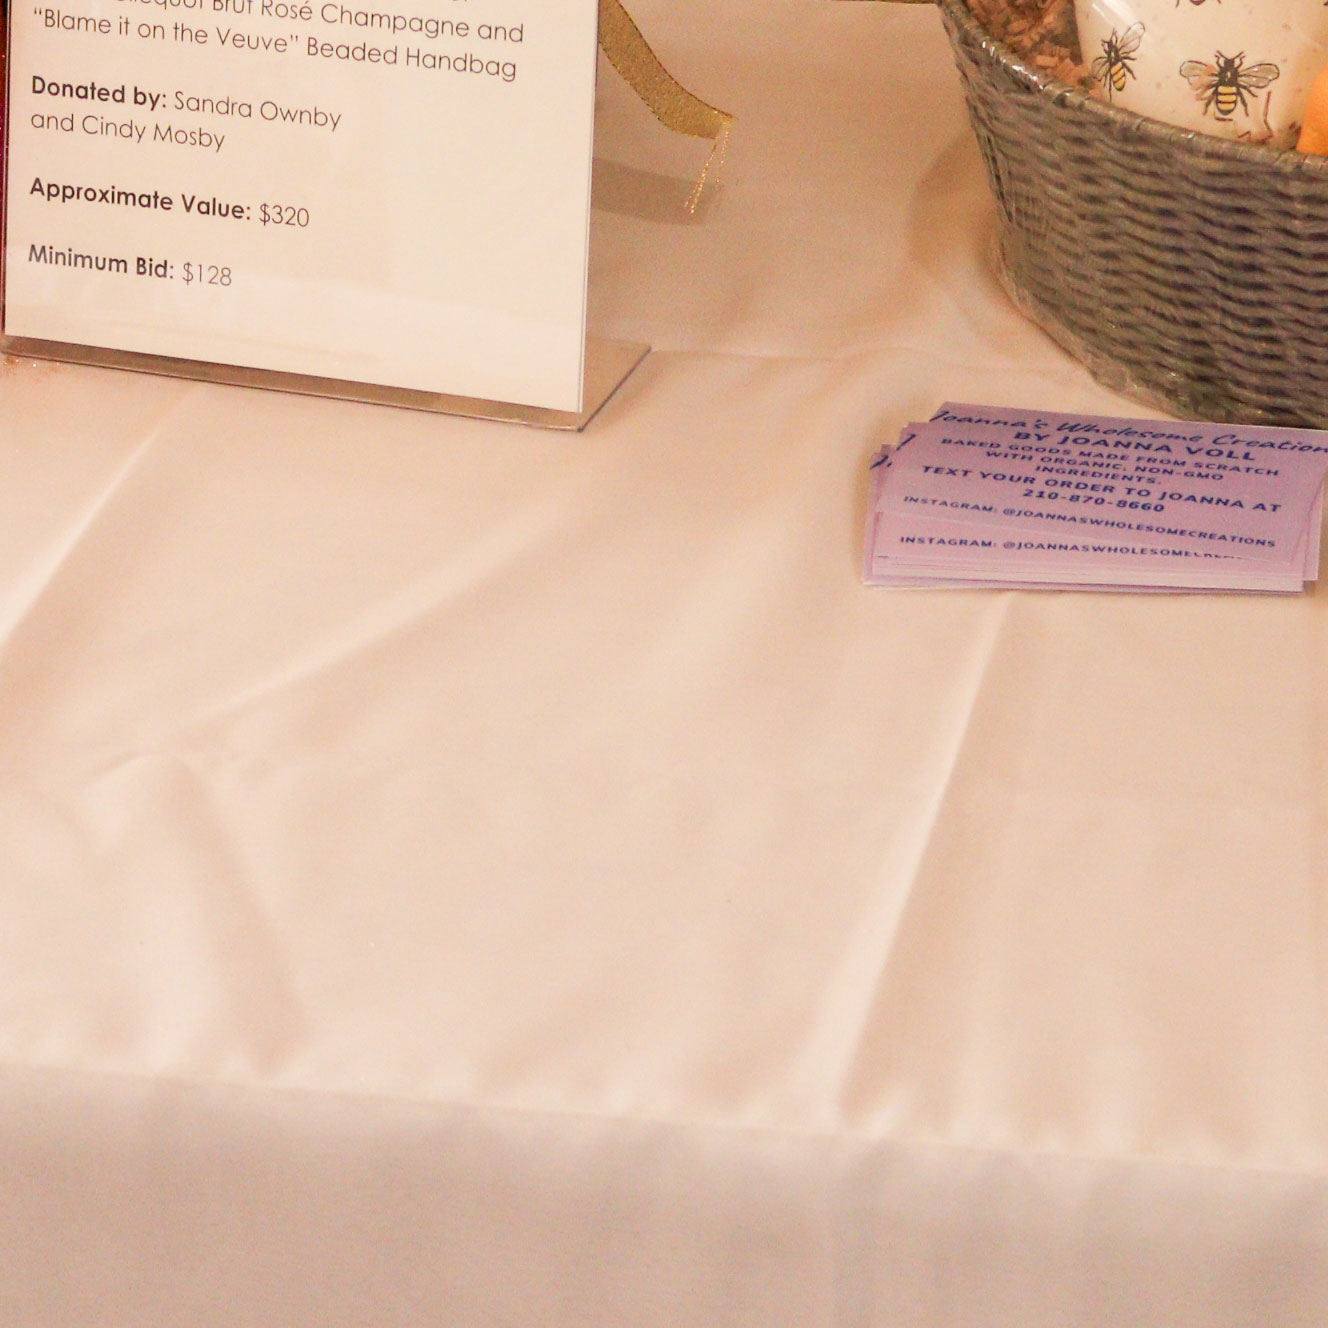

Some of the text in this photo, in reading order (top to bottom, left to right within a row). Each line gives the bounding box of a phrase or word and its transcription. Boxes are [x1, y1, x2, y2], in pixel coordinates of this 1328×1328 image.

[321, 3, 469, 40] Champagne
[477, 22, 524, 43] and
[118, 14, 131, 37] it
[137, 23, 166, 41] on
[173, 22, 208, 45] the
[307, 37, 398, 66] Beaded
[406, 46, 516, 82] Handbag
[31, 76, 342, 132] Donated by: Sandra Ownby
[31, 109, 226, 153] and Cindy Mosby
[29, 178, 310, 229] Approximate Value: $320
[28, 245, 232, 287] Minimum Bid: $128
[1013, 432, 1256, 461] BY JOANNA VOLL
[1056, 422, 1203, 442] Wholesome
[941, 438, 1279, 476] BAKED GOODS MADE FROM SCRATCH
[986, 451, 1224, 481] WITH NON-GMO
[903, 496, 997, 513] INSTAGRAM:
[922, 465, 1282, 513] TEXT YOUR ORDER TO JOANNA AT
[1023, 489, 1165, 513] 210-870-8660
[900, 536, 997, 548] INSTAGRAM:
